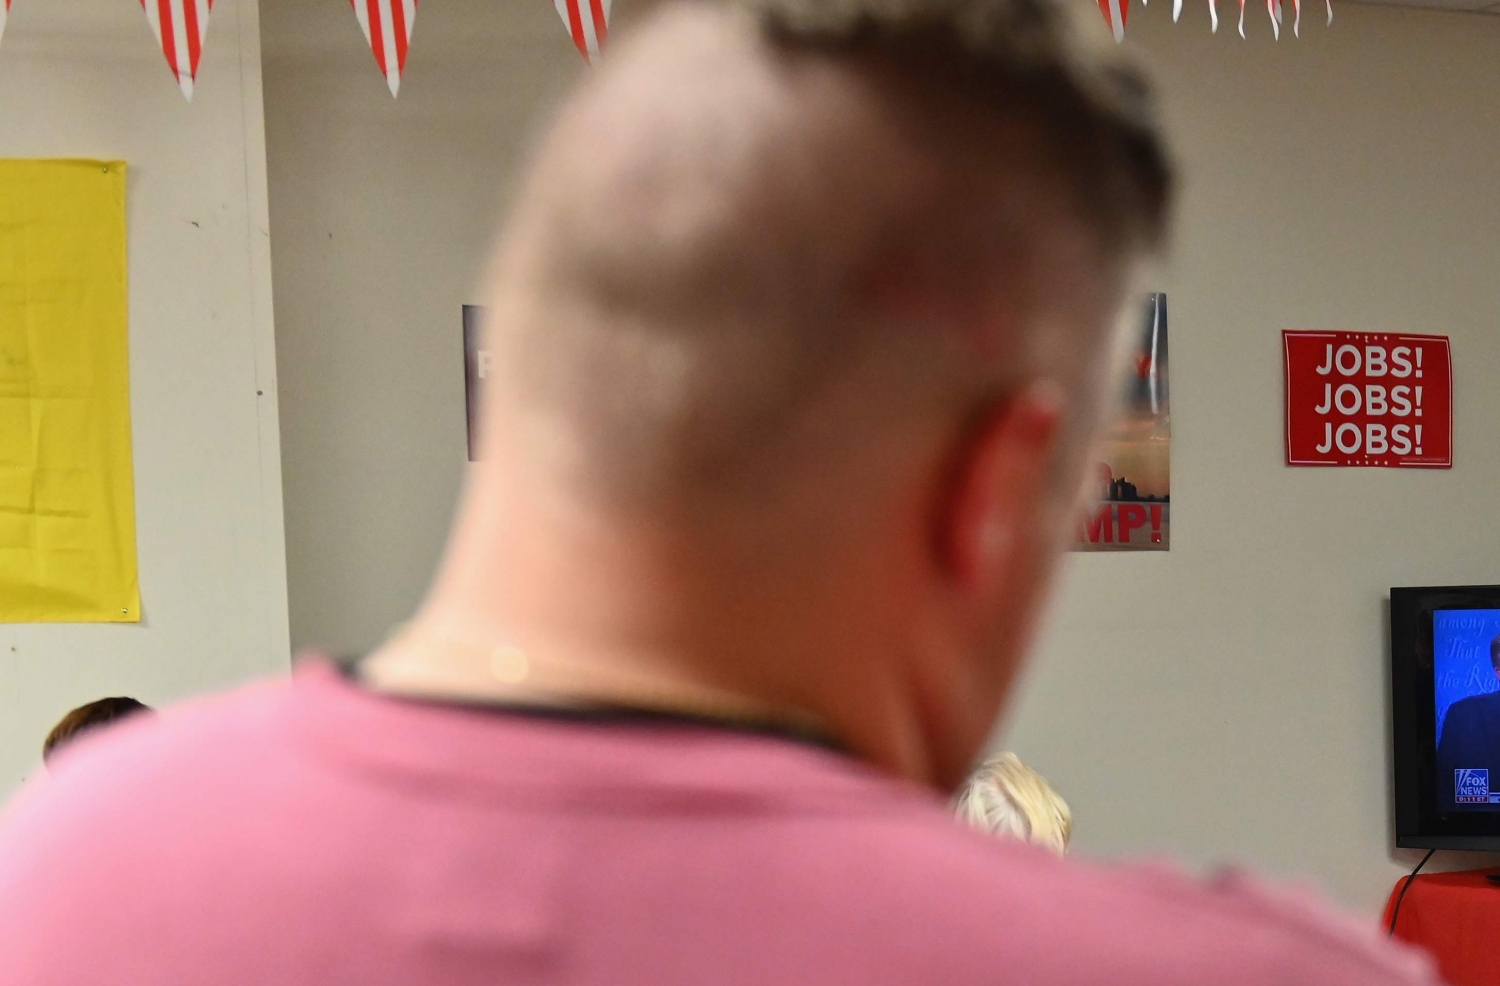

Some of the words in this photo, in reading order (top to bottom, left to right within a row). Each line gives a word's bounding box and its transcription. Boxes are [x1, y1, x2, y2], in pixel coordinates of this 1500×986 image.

[1315, 343, 1423, 378] JOBS!
[1314, 382, 1423, 417] JOBS!
[1315, 421, 1423, 455] JOBS!
[1076, 503, 1162, 543] MP!
[1460, 786, 1487, 795] NEWS
[1466, 776, 1486, 786] FOX
